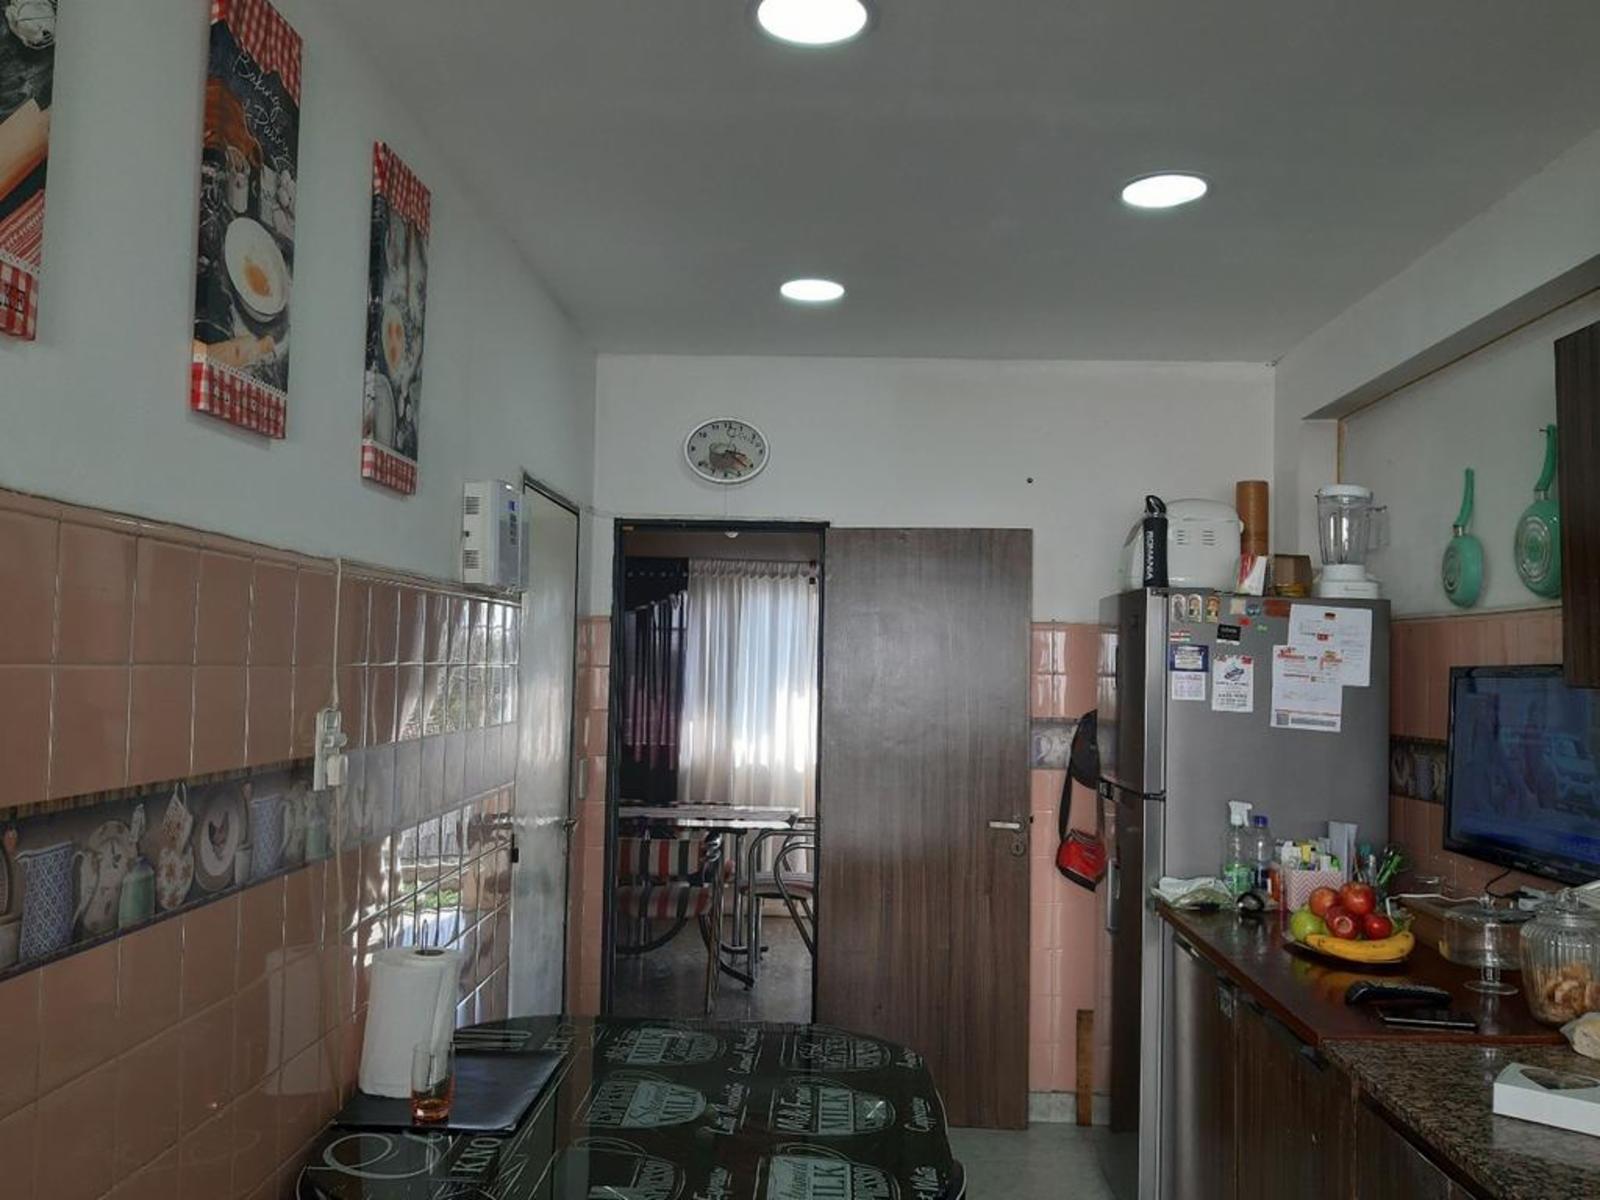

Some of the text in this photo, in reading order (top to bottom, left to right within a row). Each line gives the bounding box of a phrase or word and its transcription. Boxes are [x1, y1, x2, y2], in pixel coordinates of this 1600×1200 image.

[1146, 530, 1154, 580] ROMANIA
[821, 1094, 849, 1129] MILK
[812, 1166, 845, 1200] ILK
